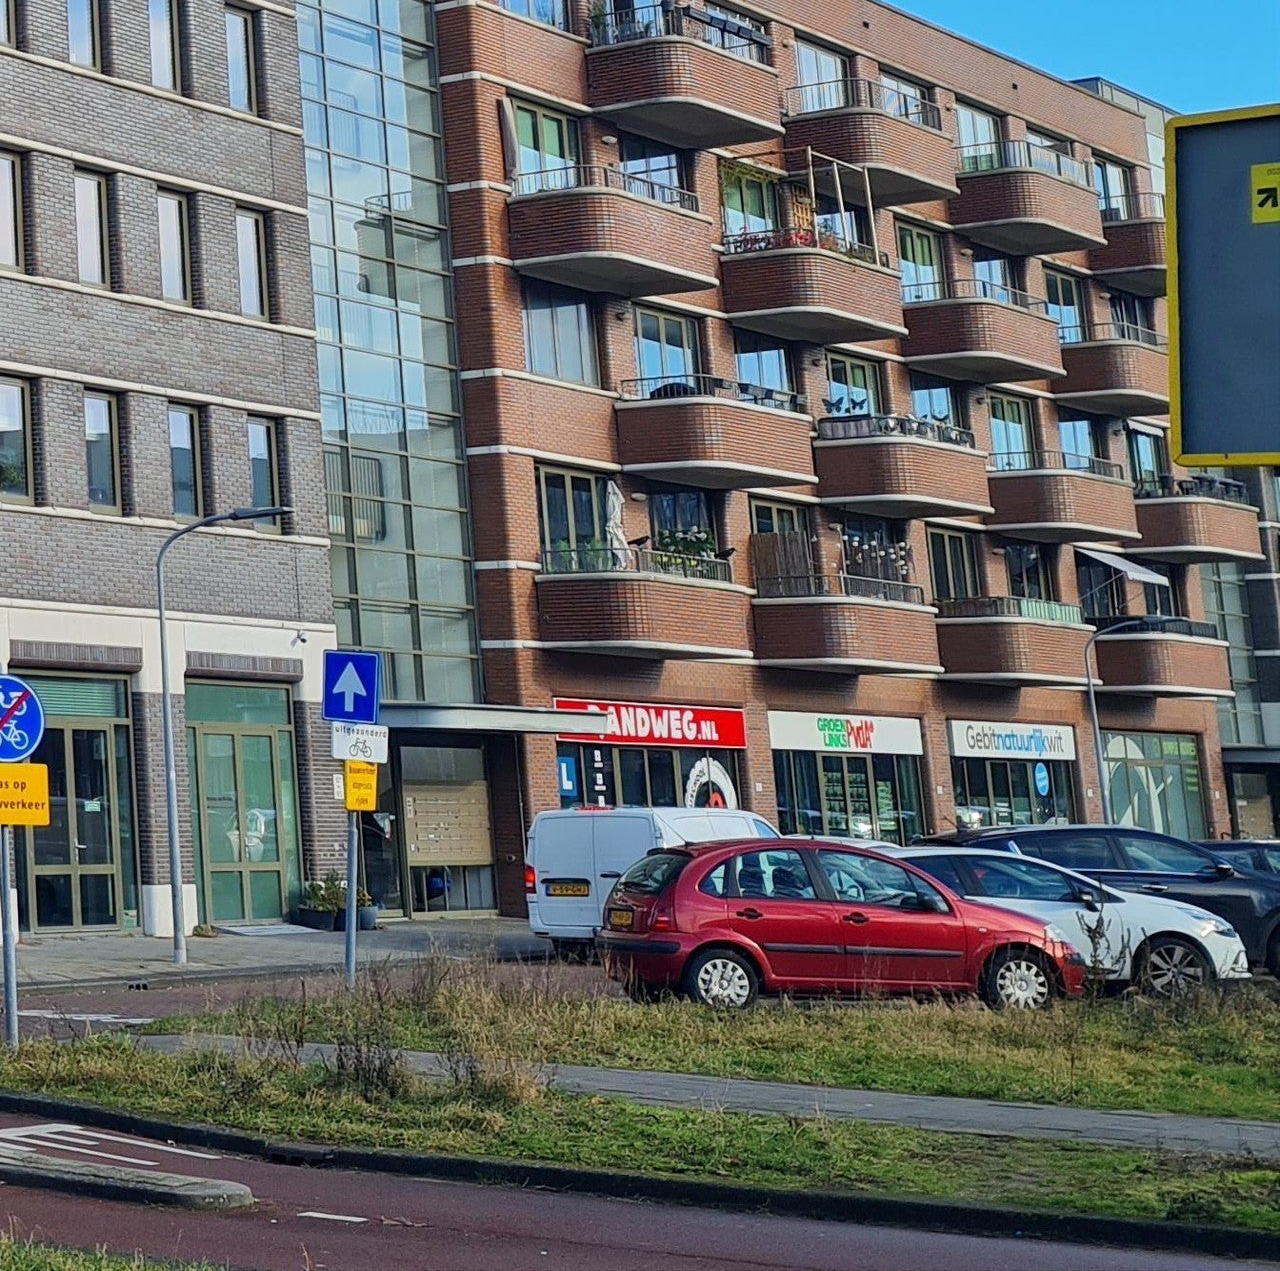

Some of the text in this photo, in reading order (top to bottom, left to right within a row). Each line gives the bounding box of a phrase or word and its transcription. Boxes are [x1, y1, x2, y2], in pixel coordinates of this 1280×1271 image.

[587, 704, 720, 741] ANDWEG.NL
[817, 717, 847, 732] GROEN
[335, 725, 387, 738] uitgezonderd
[824, 732, 848, 747] LINKS
[560, 763, 573, 790] L
[13, 781, 27, 792] op
